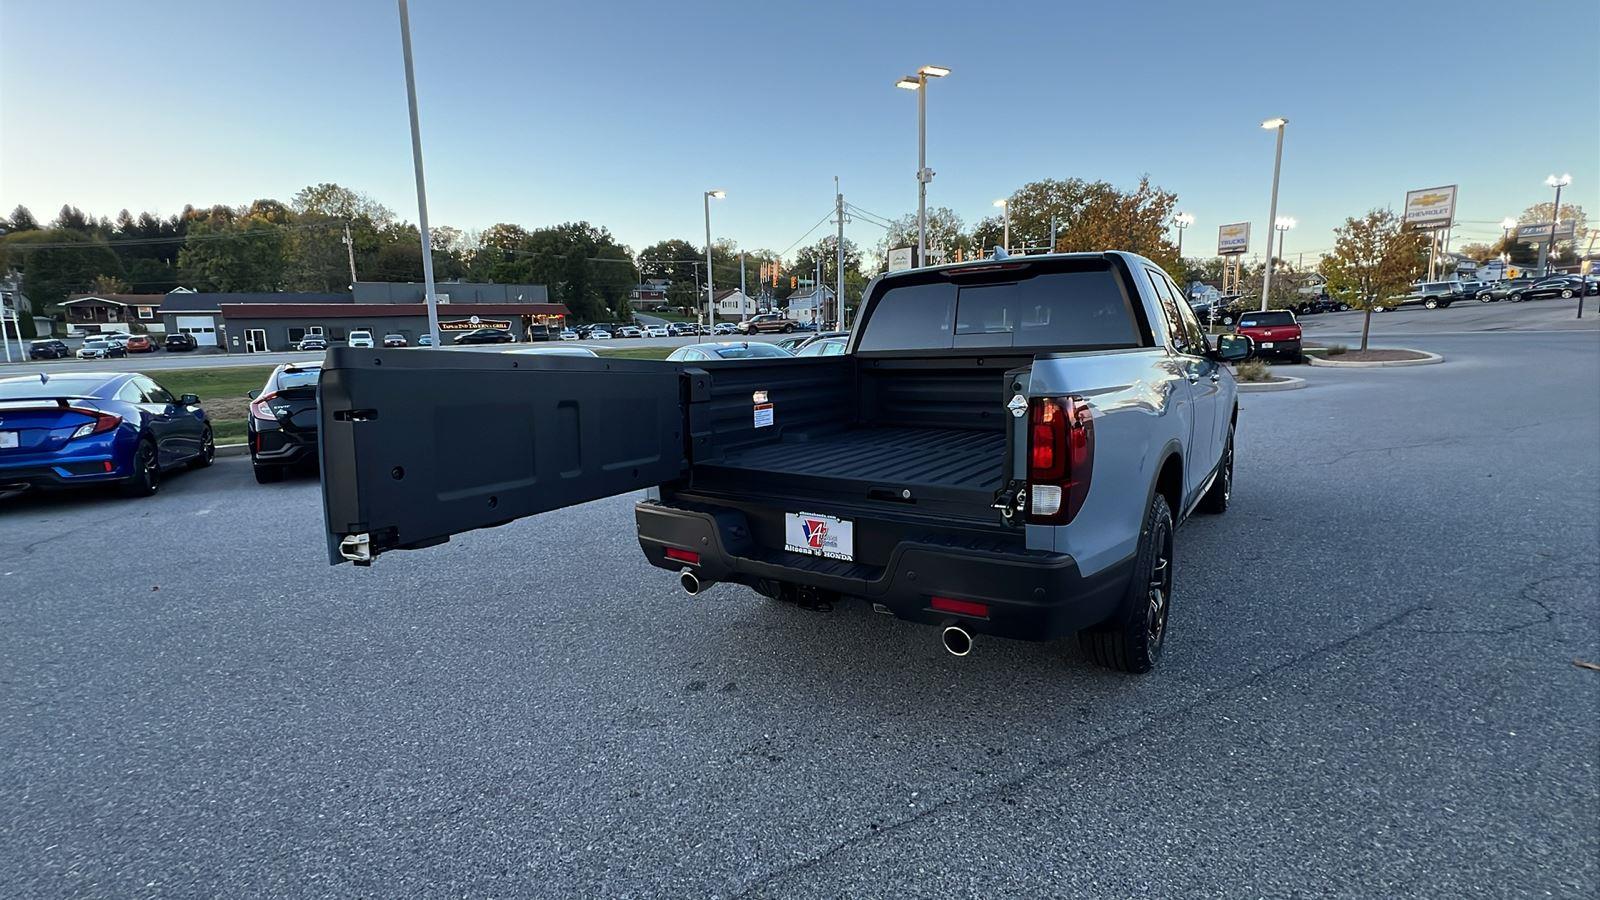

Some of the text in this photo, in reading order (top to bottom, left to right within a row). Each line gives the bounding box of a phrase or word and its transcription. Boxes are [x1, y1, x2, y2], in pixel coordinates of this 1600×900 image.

[1408, 207, 1449, 218] CHEVROLET
[1221, 238, 1246, 246] TRUCKS
[784, 544, 813, 554] Altoona
[823, 550, 853, 561] HONDA
